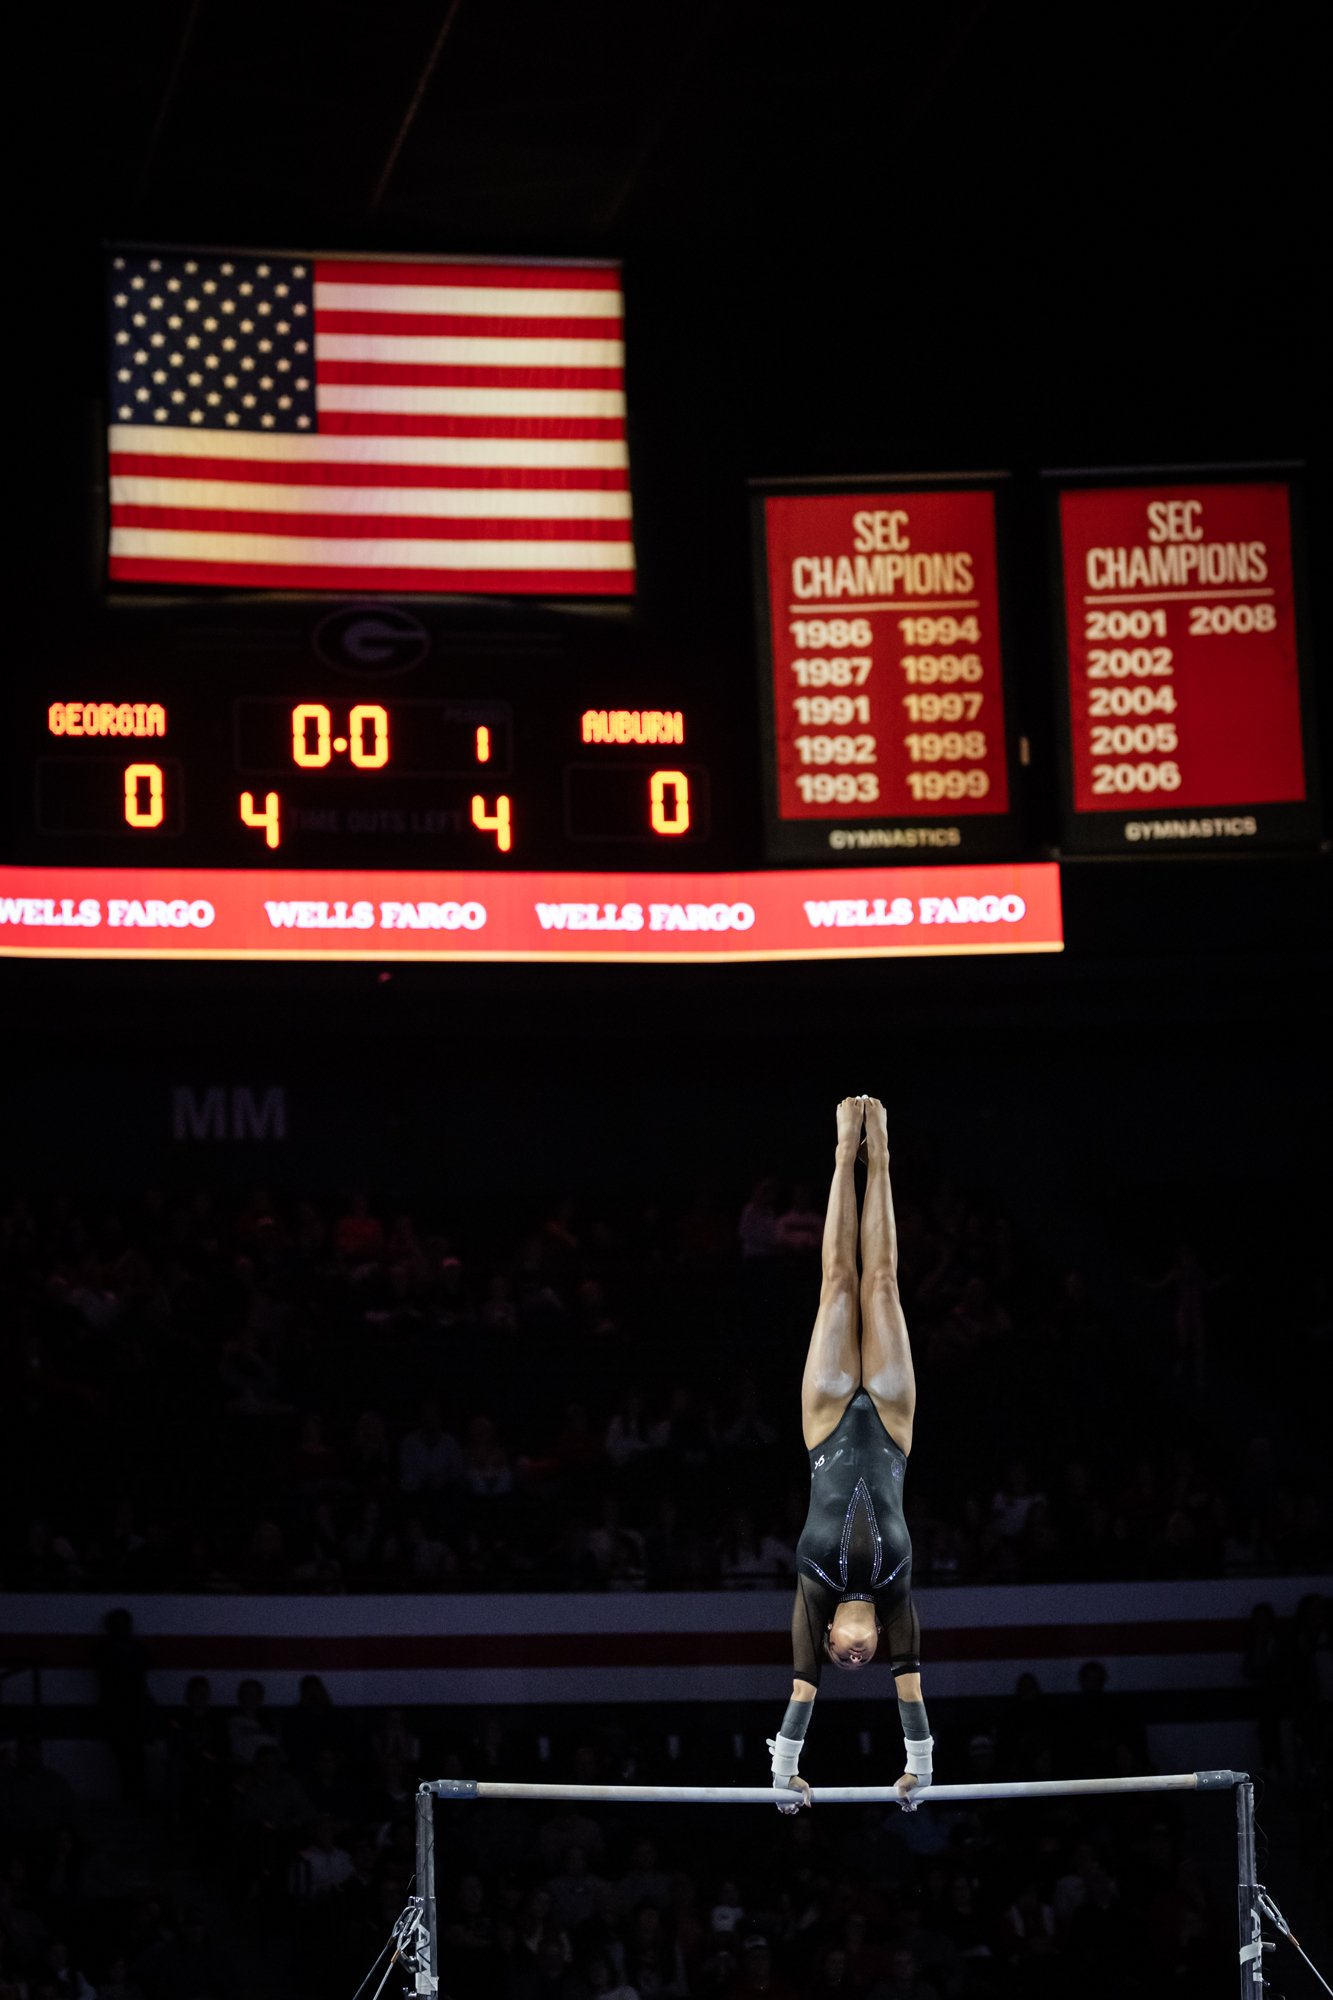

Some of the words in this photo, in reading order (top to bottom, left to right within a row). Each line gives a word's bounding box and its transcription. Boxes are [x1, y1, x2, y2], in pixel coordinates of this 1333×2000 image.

[853, 510, 909, 551] SEC
[1147, 501, 1203, 543] SEC
[792, 552, 974, 598] CHAMPIONS
[1086, 541, 1269, 590] CHAMPIONS
[790, 619, 873, 649] 1986
[898, 616, 980, 646] 1994
[1085, 609, 1166, 640] 2001
[1189, 604, 1276, 635] 2008
[792, 657, 872, 687] 1987
[900, 654, 983, 684] 1996
[1087, 647, 1173, 679] 2002
[794, 695, 870, 725] 1991
[903, 693, 983, 722] 1997
[1089, 685, 1177, 716] 2004
[49, 703, 165, 736] GEORGIA
[582, 710, 683, 743] AUBURN
[477, 726, 489, 761] 1
[795, 735, 876, 765] 1992
[904, 731, 986, 762] 1998
[1090, 723, 1178, 755] 2005
[796, 773, 880, 803] 1993
[907, 770, 989, 800] 1999
[1092, 761, 1181, 794] 2006
[125, 764, 163, 827] 0
[651, 771, 689, 834] 0
[241, 792, 279, 848] 4
[472, 795, 511, 851] 4
[1125, 817, 1256, 841] GYMNASTICS
[829, 827, 961, 849] GYMNASTICS
[0, 899, 101, 926] WELLS
[109, 900, 214, 927] FARGO
[266, 902, 374, 928] WELLS
[381, 902, 486, 929] FARGO
[536, 904, 643, 930] WELLS
[650, 903, 754, 930] FARGO
[805, 898, 913, 926] WELLS
[920, 895, 1025, 923] FARGO
